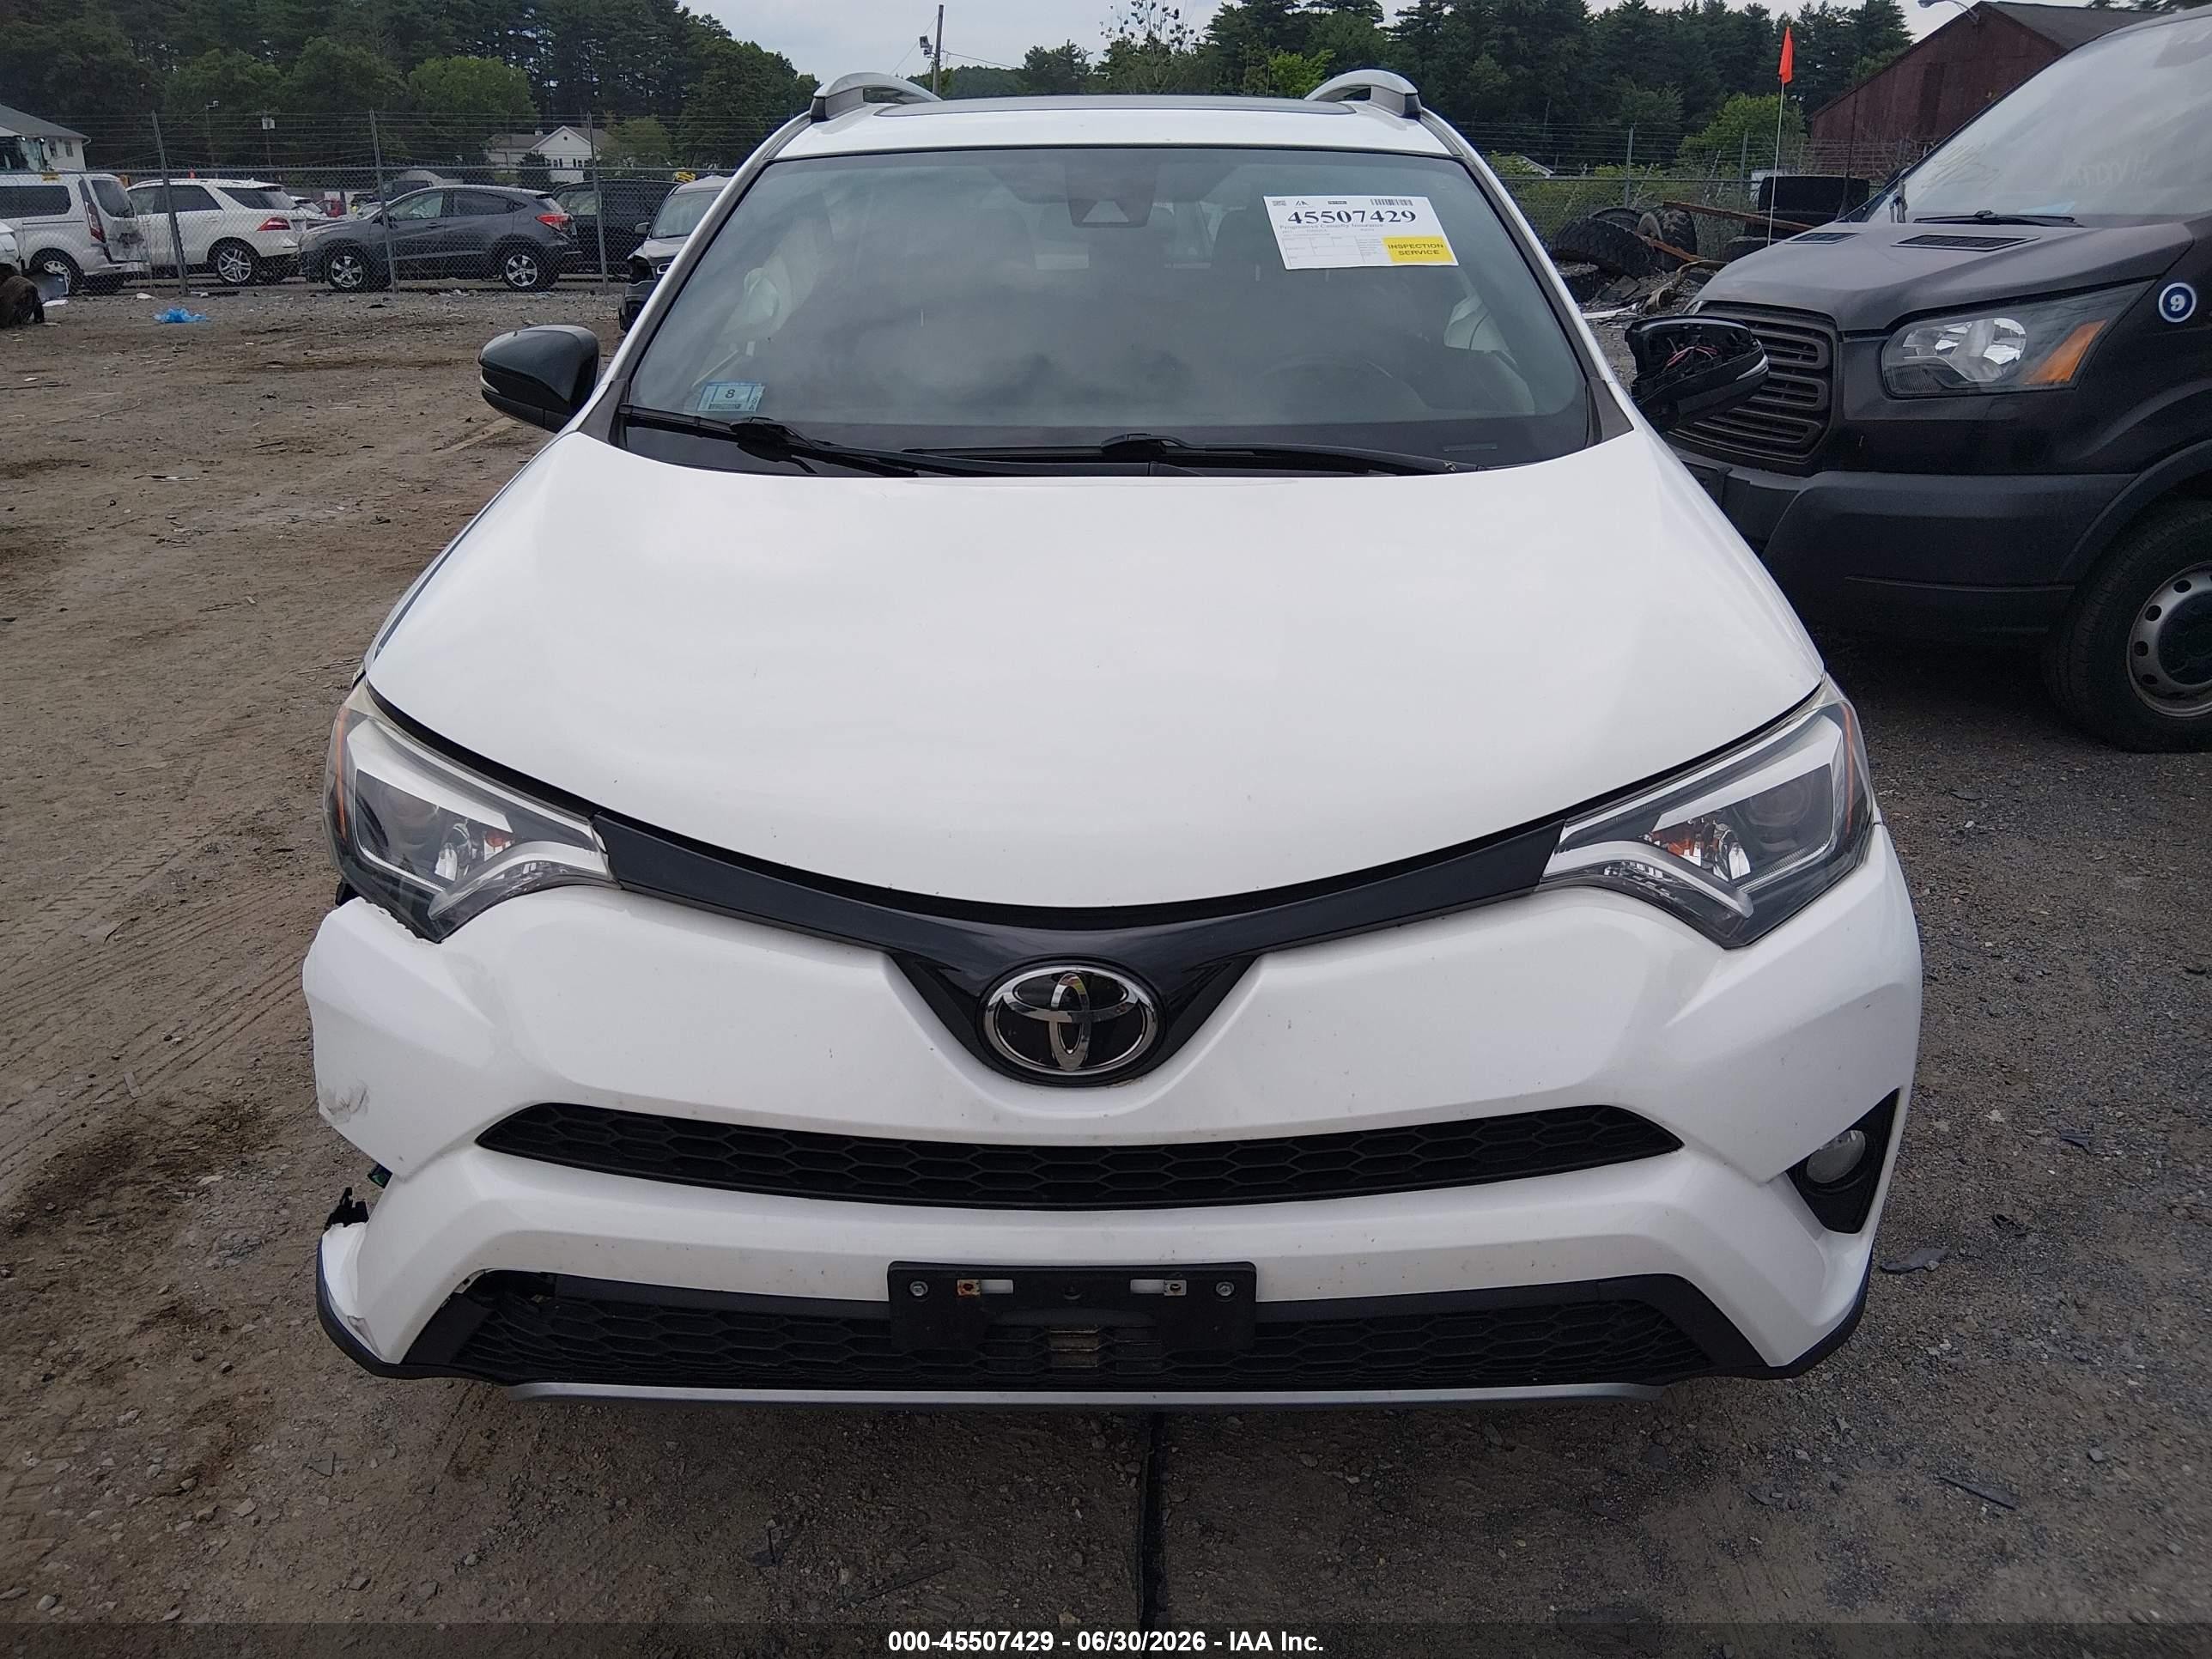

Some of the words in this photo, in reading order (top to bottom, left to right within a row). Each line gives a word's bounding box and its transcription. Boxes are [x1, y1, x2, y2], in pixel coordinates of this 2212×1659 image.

[1287, 210, 1416, 224] 45507429
[2170, 295, 2186, 312] 9
[725, 388, 736, 398] 8
